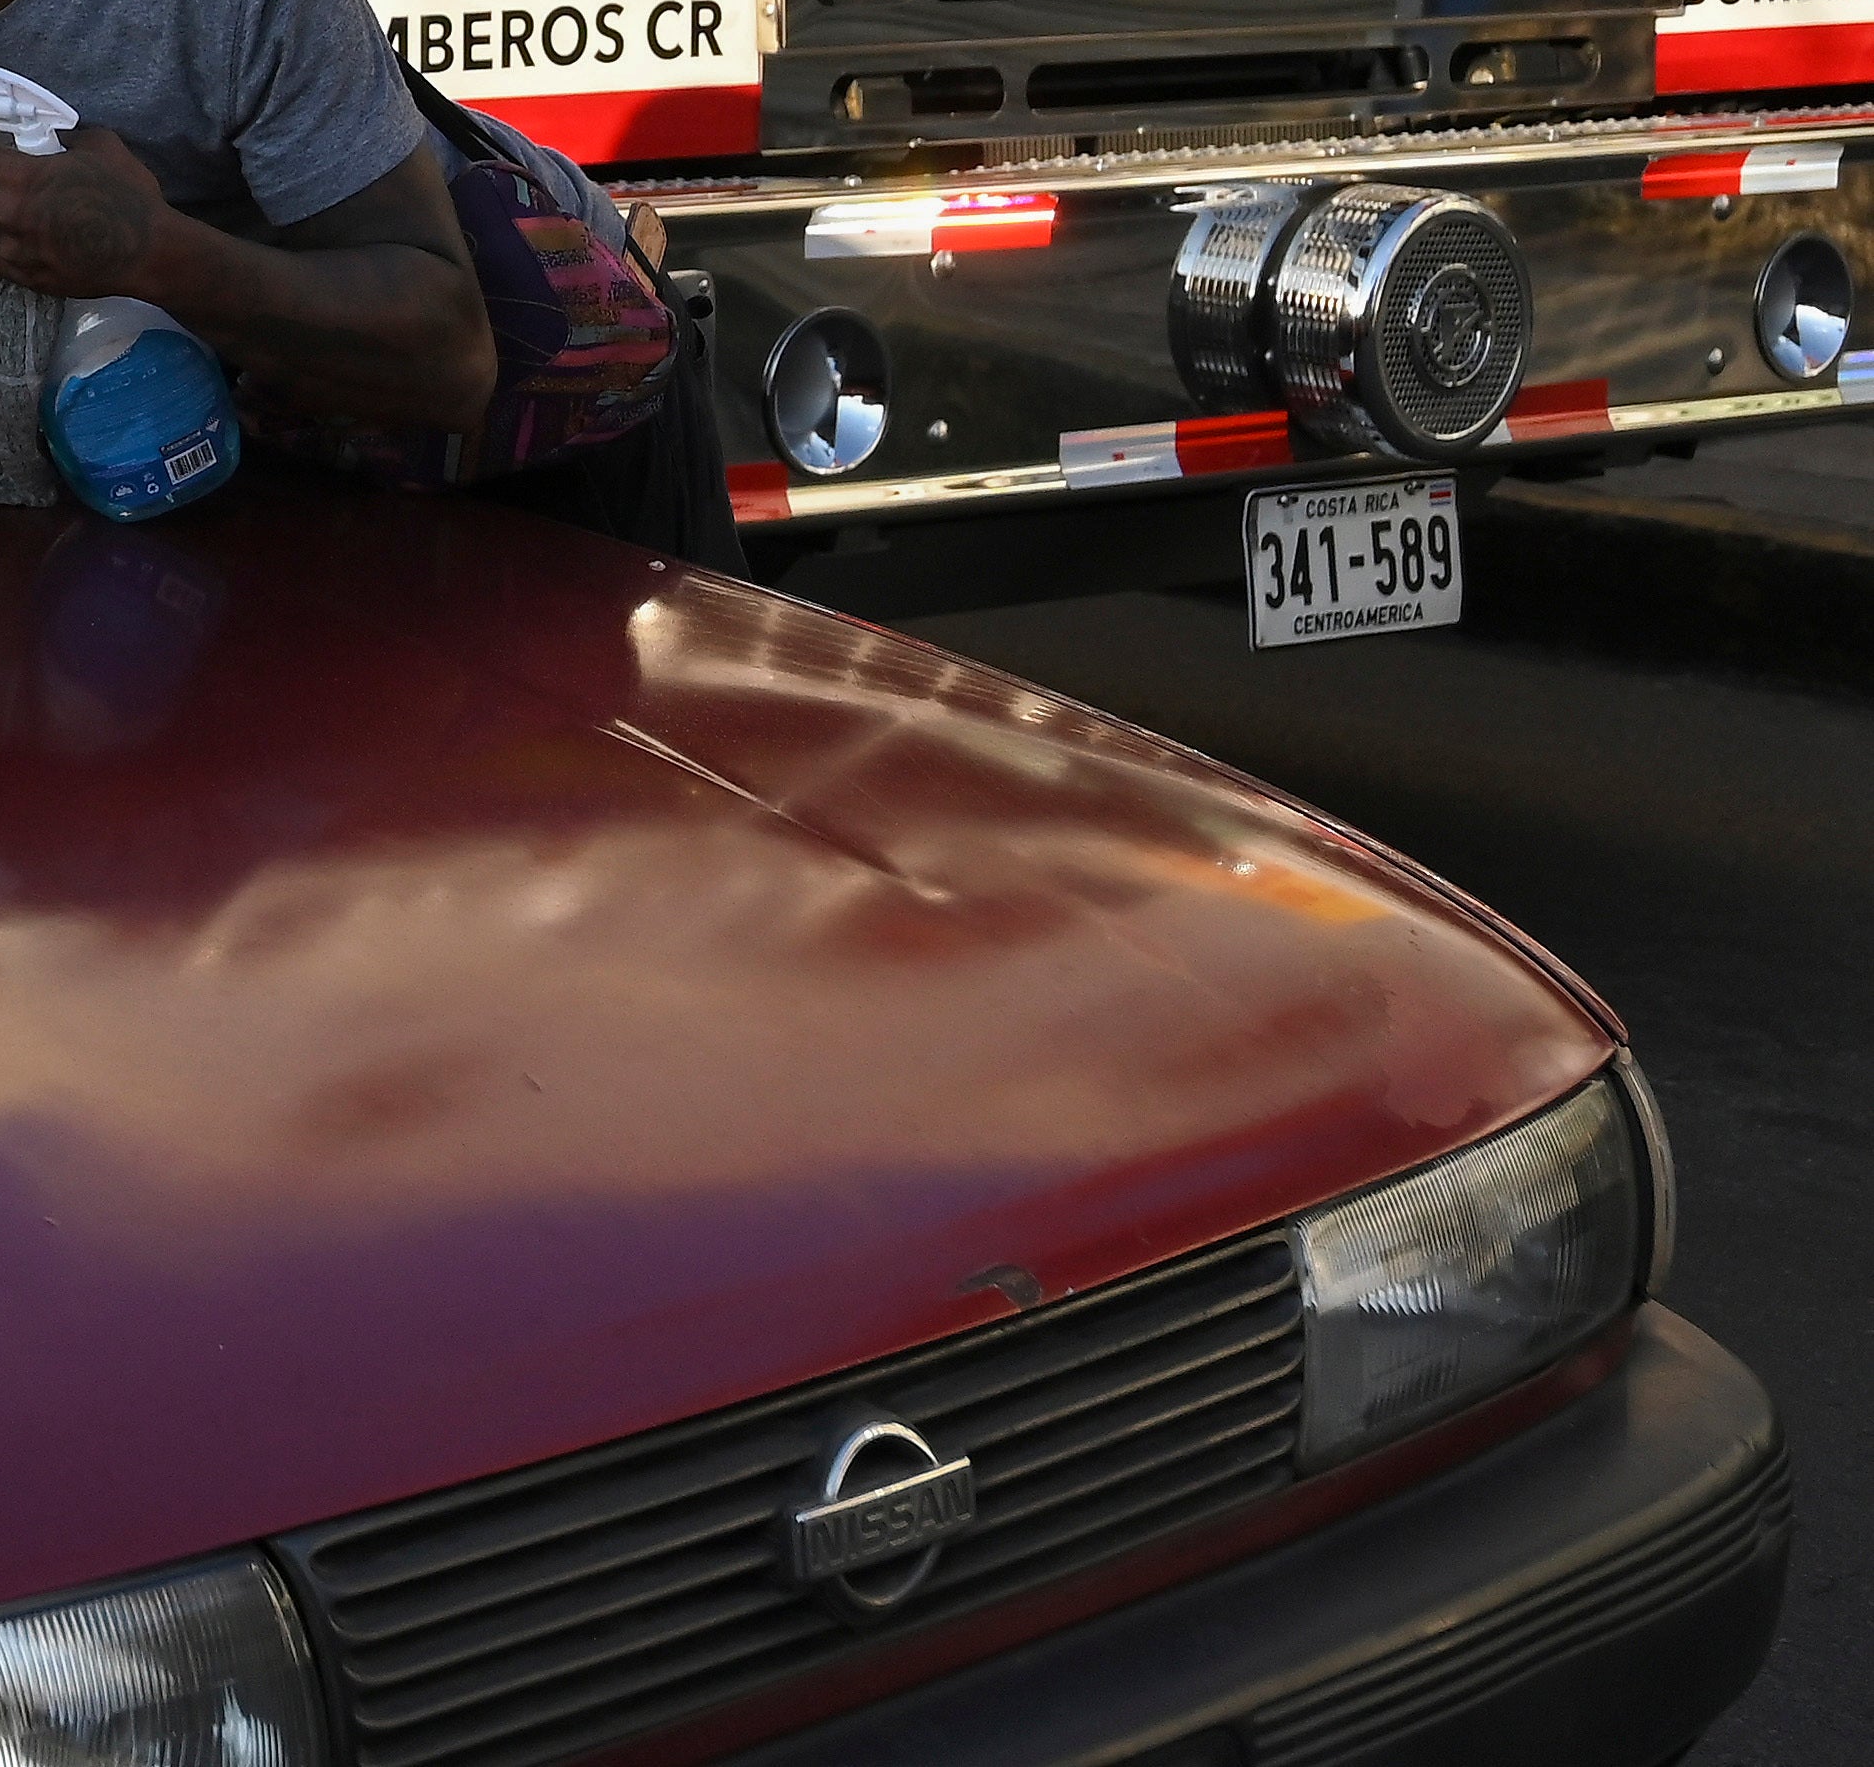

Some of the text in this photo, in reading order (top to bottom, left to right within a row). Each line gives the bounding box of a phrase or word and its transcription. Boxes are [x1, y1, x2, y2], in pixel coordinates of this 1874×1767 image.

[646, 0, 724, 60] CR
[1305, 491, 1400, 519] COSTA RICA
[1261, 515, 1452, 609] 341-589
[1293, 601, 1424, 635] CENTROAMERICA
[806, 1468, 974, 1571] NISSAN
